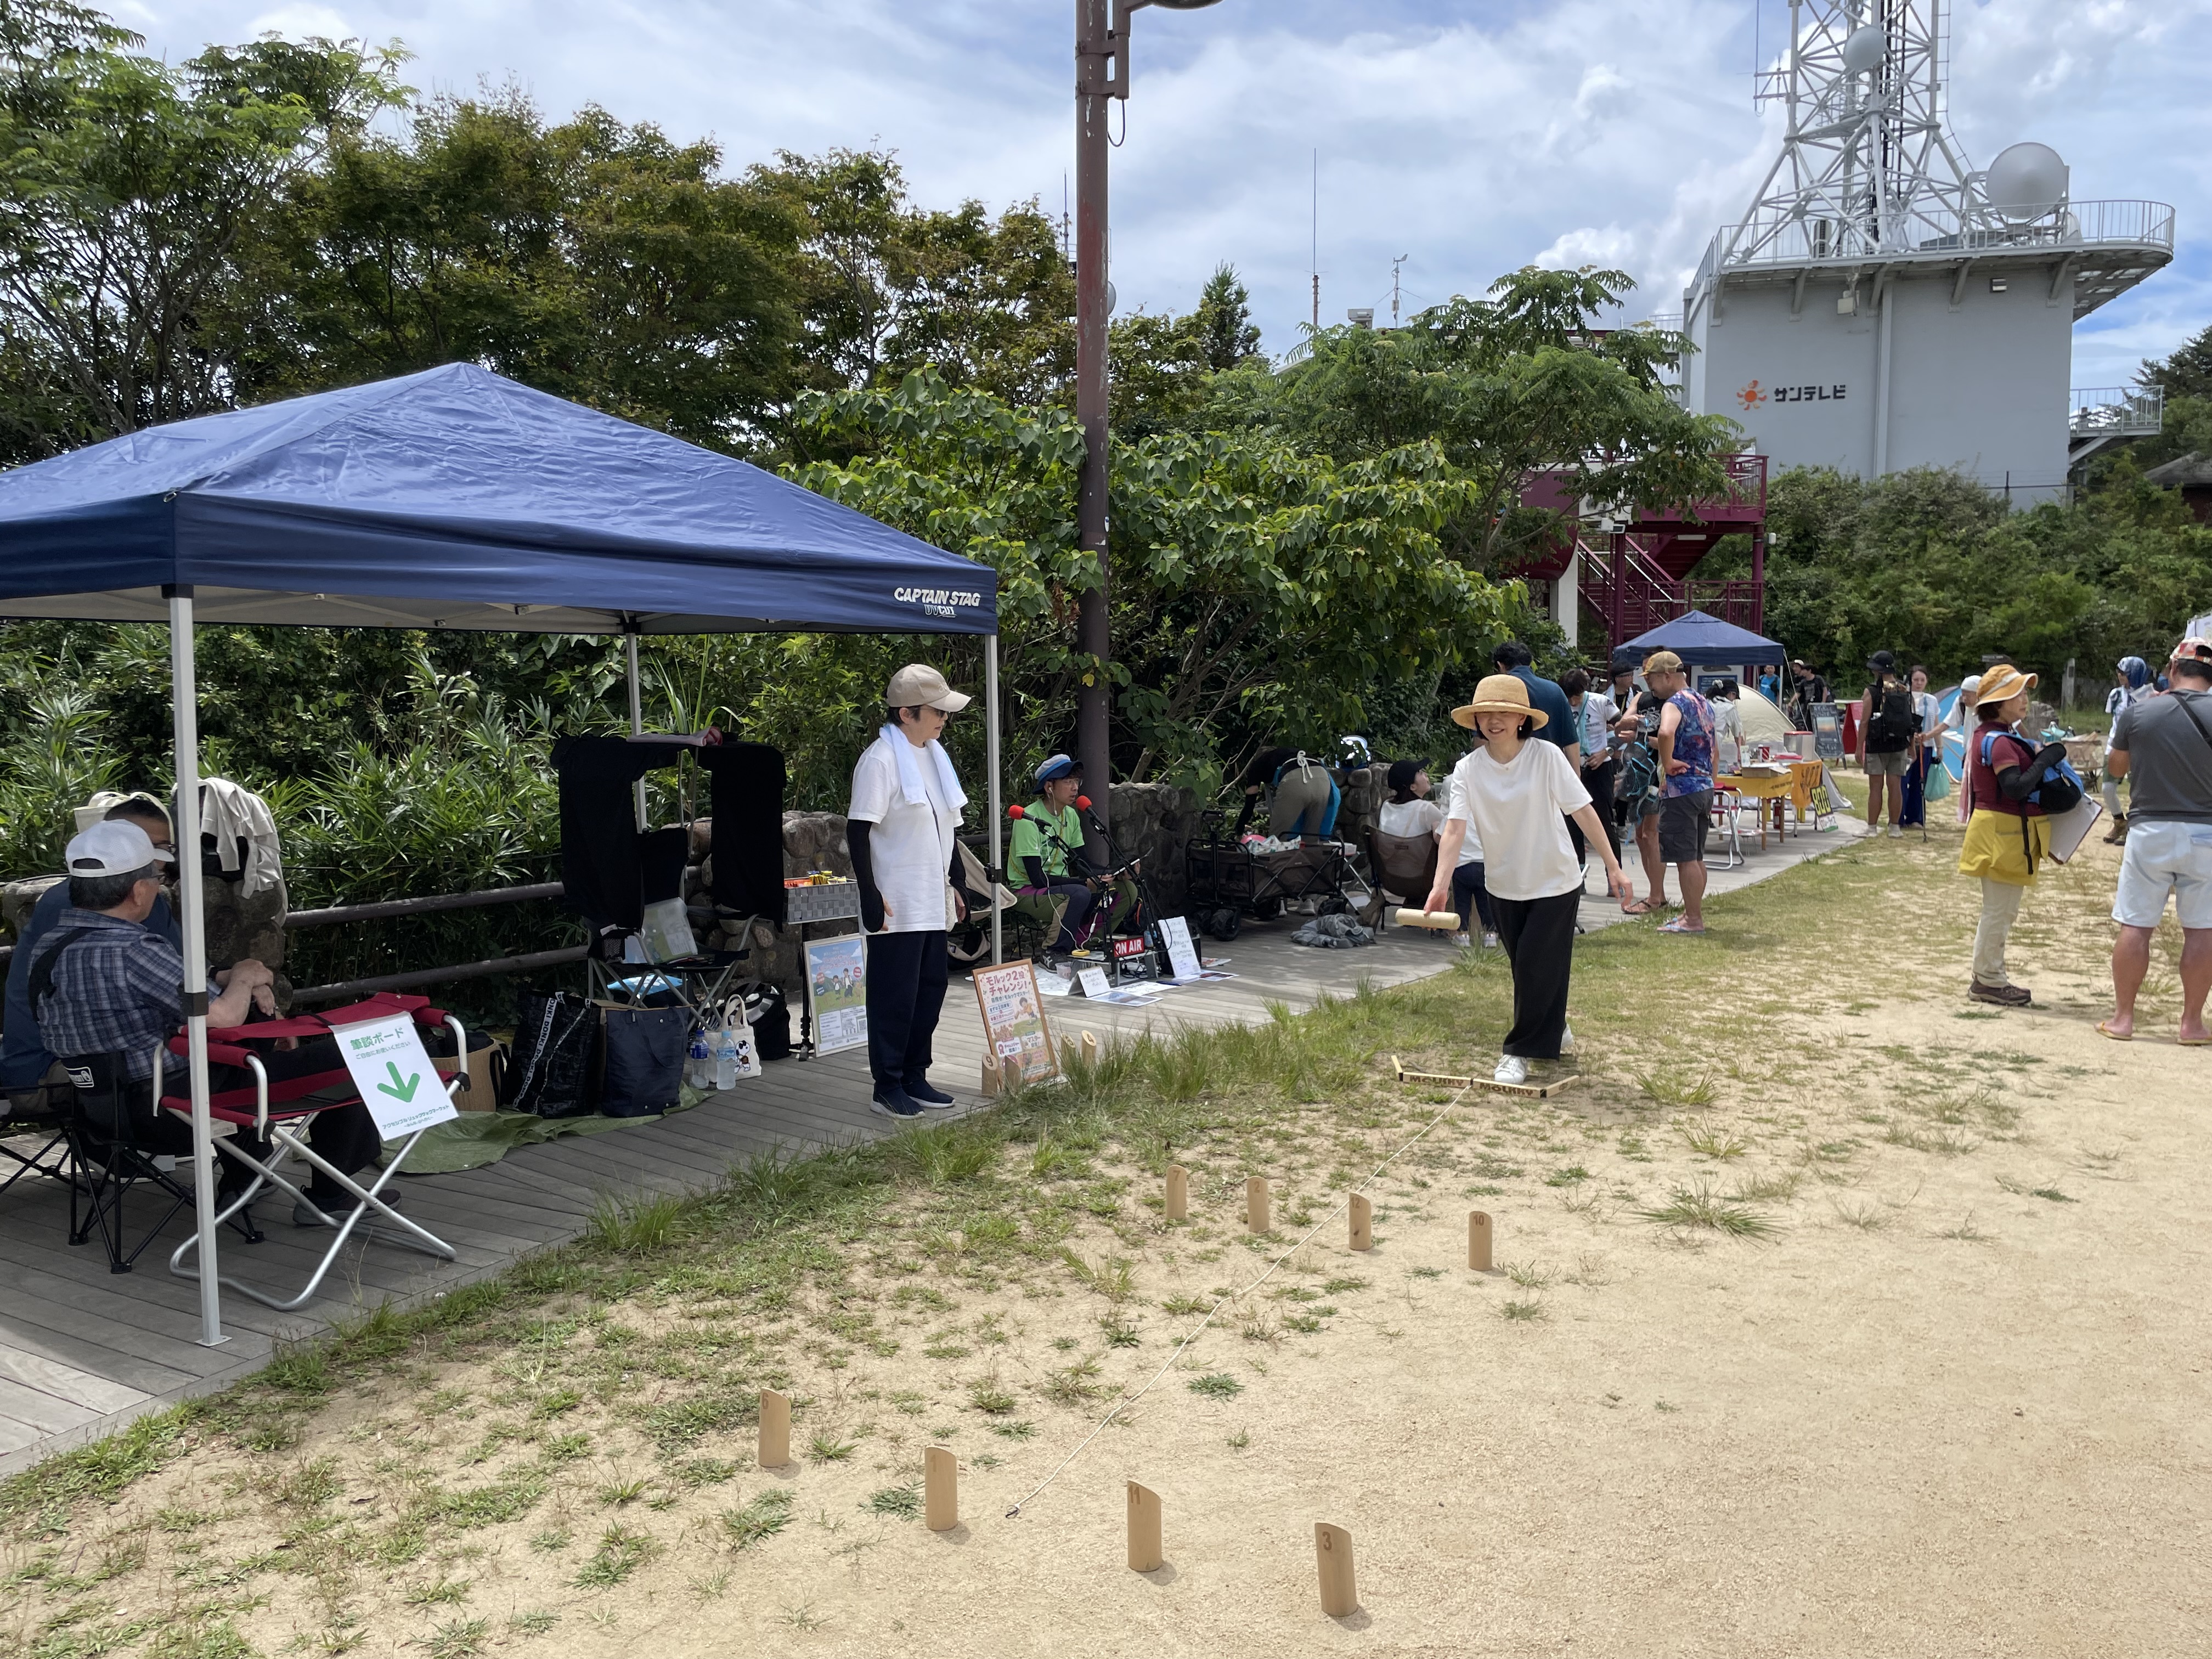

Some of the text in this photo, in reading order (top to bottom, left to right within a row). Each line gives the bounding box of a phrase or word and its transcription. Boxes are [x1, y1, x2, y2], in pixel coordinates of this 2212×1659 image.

[1774, 385, 1846, 402] サンテレビ
[894, 587, 981, 607] CAPTAIN STAG
[1115, 939, 1142, 955] ON AIR
[986, 970, 1025, 986] モルック2投
[989, 980, 1028, 996] チャレンジ！
[546, 998, 556, 1019] ONKI
[350, 1027, 404, 1051] 筆談ボード
[538, 1021, 550, 1046] DONKI
[356, 1041, 411, 1060] ご自由にお使いください
[985, 1056, 994, 1067] 9
[1173, 1170, 1181, 1181] 7
[1254, 1181, 1260, 1193] 2
[1351, 1197, 1361, 1209] 12
[1474, 1214, 1485, 1226] 10
[762, 1392, 769, 1410] 6
[930, 1454, 937, 1472] 1
[1128, 1485, 1141, 1505] 11
[1322, 1531, 1332, 1551] 3
